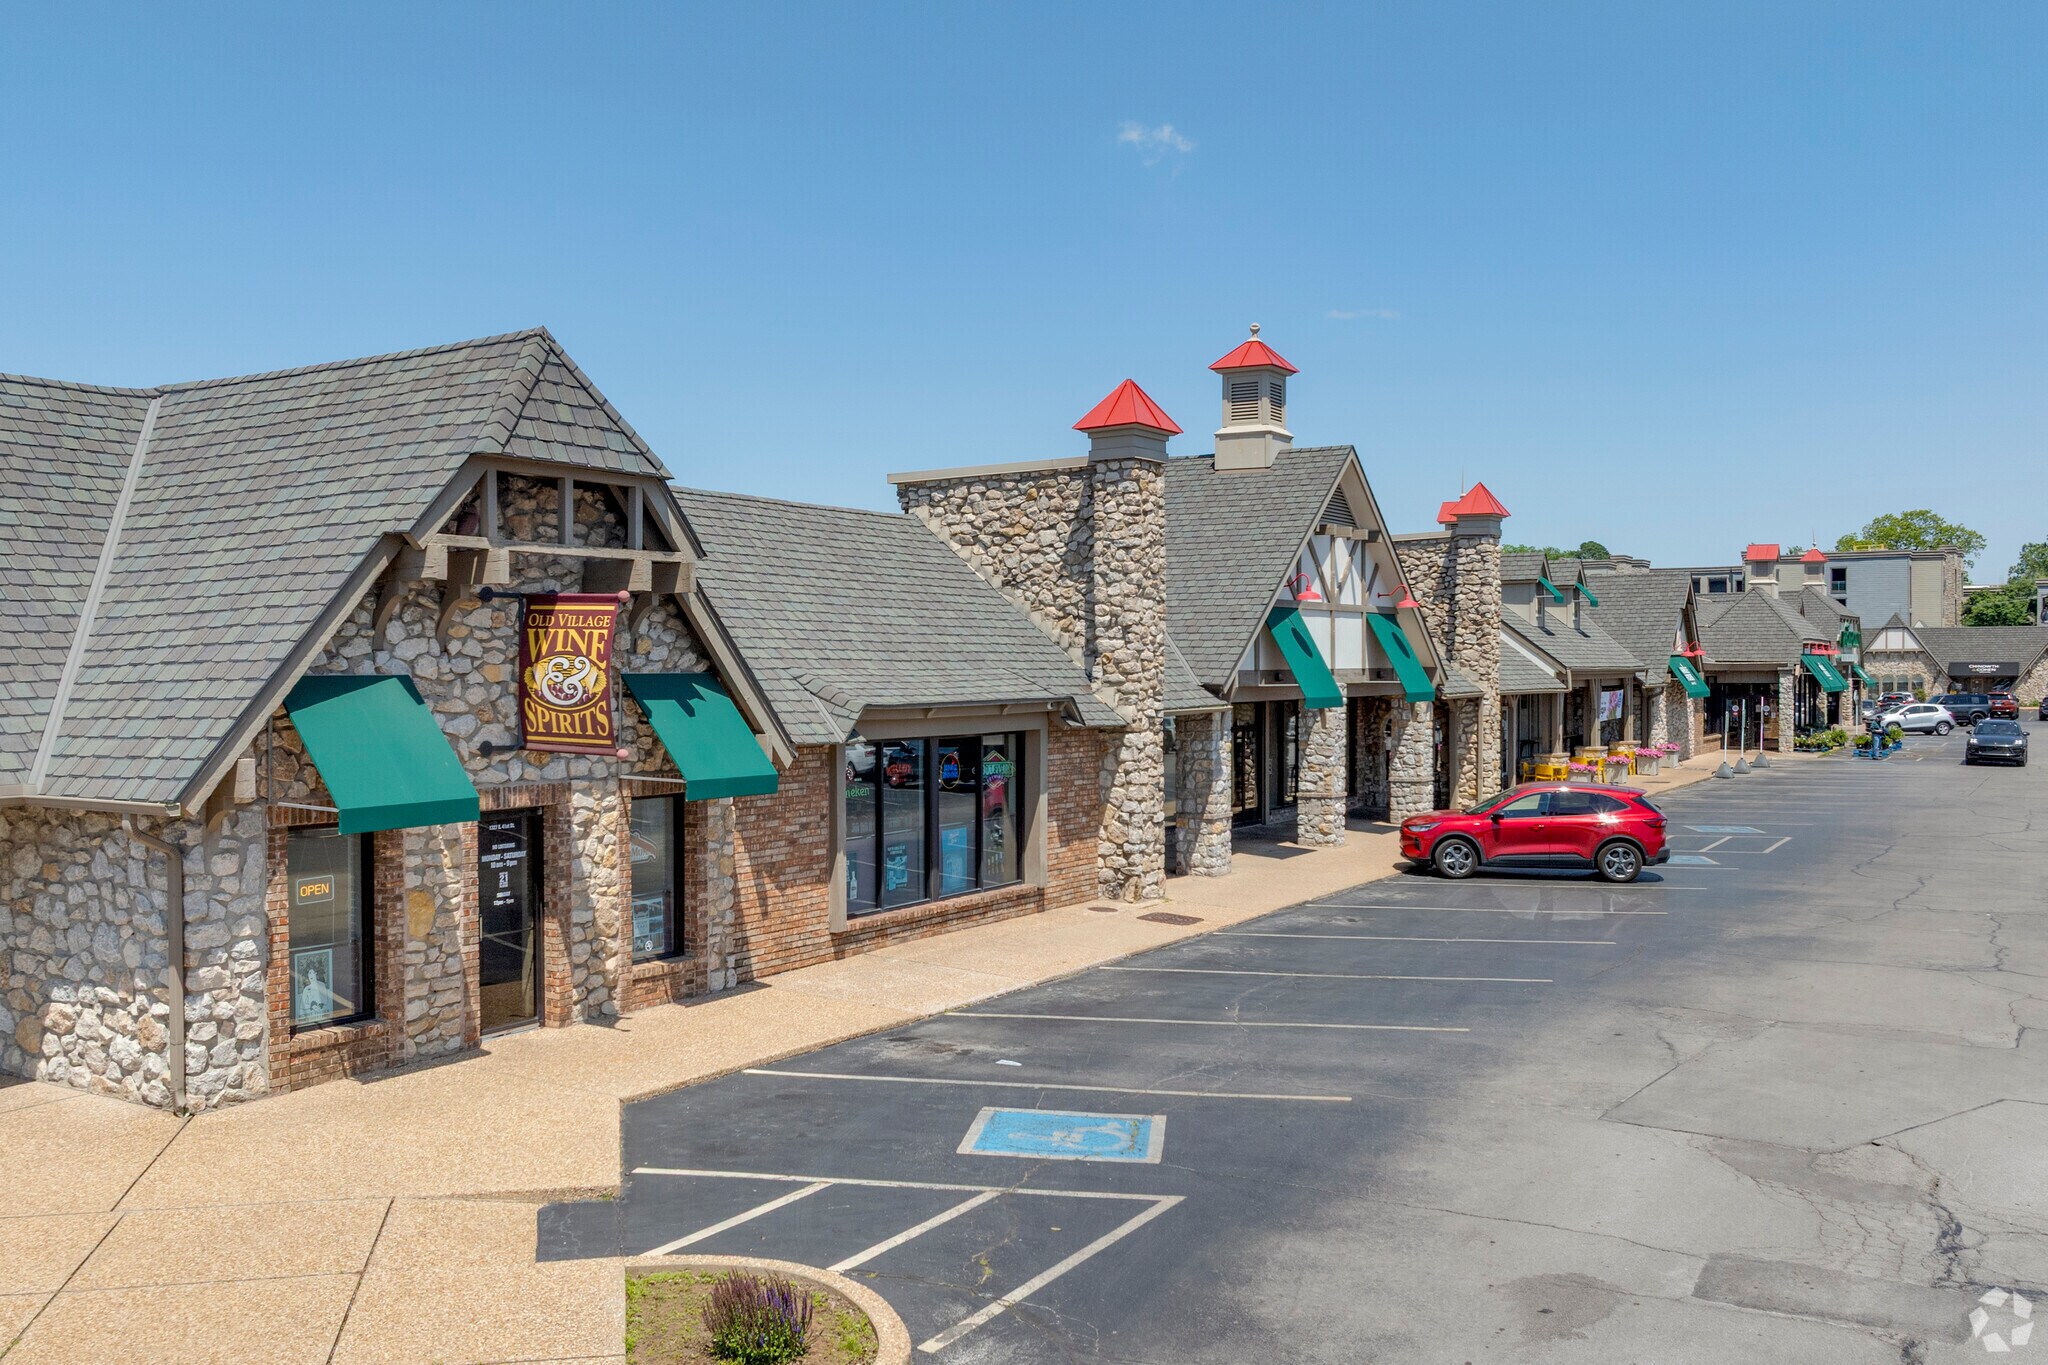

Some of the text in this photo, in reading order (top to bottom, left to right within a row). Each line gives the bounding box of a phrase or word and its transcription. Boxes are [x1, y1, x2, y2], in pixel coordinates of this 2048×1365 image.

[528, 613, 611, 627] OLD VILLAGE
[526, 628, 609, 670] WINE
[541, 655, 591, 705] &
[524, 697, 609, 737] SPIRITS
[845, 786, 869, 798] neken
[300, 883, 329, 897] OPEN
